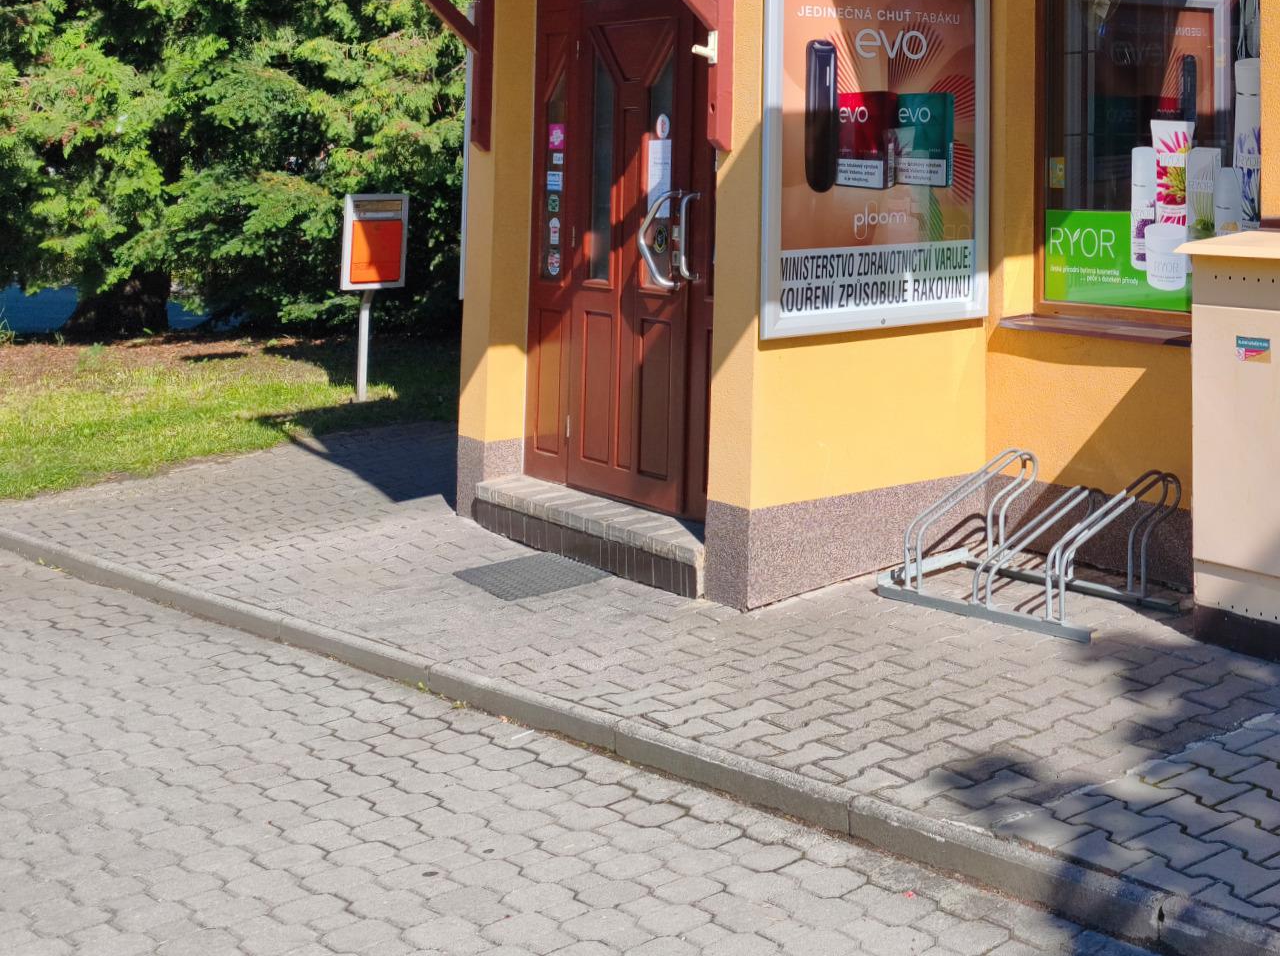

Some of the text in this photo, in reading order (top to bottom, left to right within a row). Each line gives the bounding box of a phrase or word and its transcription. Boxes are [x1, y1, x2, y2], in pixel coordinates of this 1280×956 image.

[797, 5, 960, 25] JEDINEČNÁ CHUŤ TABÁKU
[855, 28, 927, 60] evo
[839, 106, 868, 123] evo
[898, 106, 931, 123] evo
[853, 203, 907, 240] ploom
[1049, 227, 1116, 259] RYOR
[780, 244, 972, 282] MINISTERSTVO ZDRAVOTNICTVÍ VARUJE:
[838, 278, 908, 309] ZPŮSOBUJE
[912, 274, 971, 302] RAKOVINU
